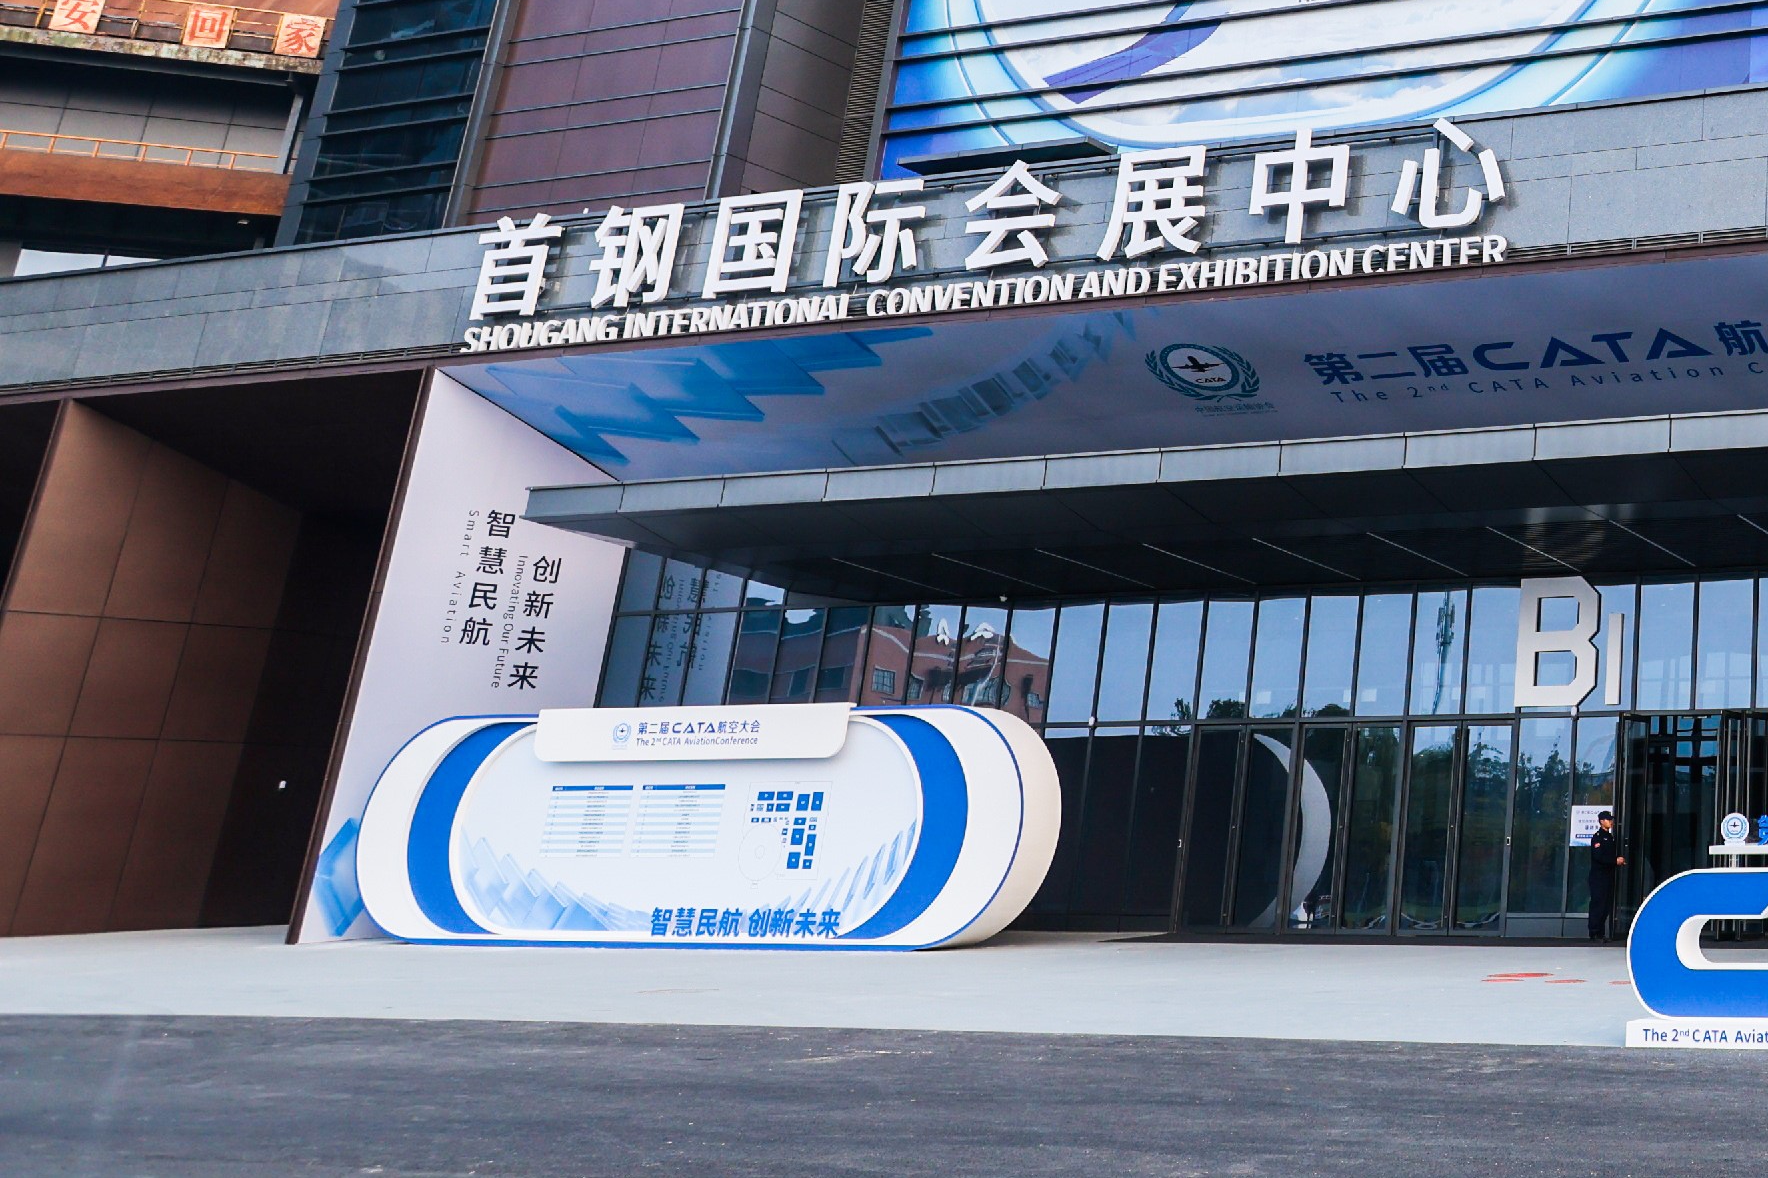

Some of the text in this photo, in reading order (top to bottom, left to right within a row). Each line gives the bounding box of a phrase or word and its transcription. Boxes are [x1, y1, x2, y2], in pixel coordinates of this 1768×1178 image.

[470, 118, 1505, 320] 首钢国际会展中心
[460, 234, 1507, 353] SHOUGANG INTERNATIONAL CONVENTION AND EXHIBITION CENTER
[1195, 376, 1226, 384] CATA
[1330, 389, 1388, 404] The
[1407, 382, 1449, 399] 2nd
[1468, 376, 1549, 394] CATA
[1571, 365, 1724, 387] Aviation
[440, 510, 479, 644] Smart Aviation
[459, 509, 516, 646] 智慧民航
[491, 555, 528, 689] Innovating Our Future
[507, 555, 562, 690] 创新未来
[1514, 576, 1625, 707] B1
[637, 719, 761, 735] 第二届CATA航空大会
[637, 737, 649, 747] The
[650, 906, 841, 938] 智慧民航 创新未来
[1643, 1028, 1667, 1042] The
[1672, 1028, 1690, 1042] 2nd
[1692, 1030, 1728, 1043] CATA
